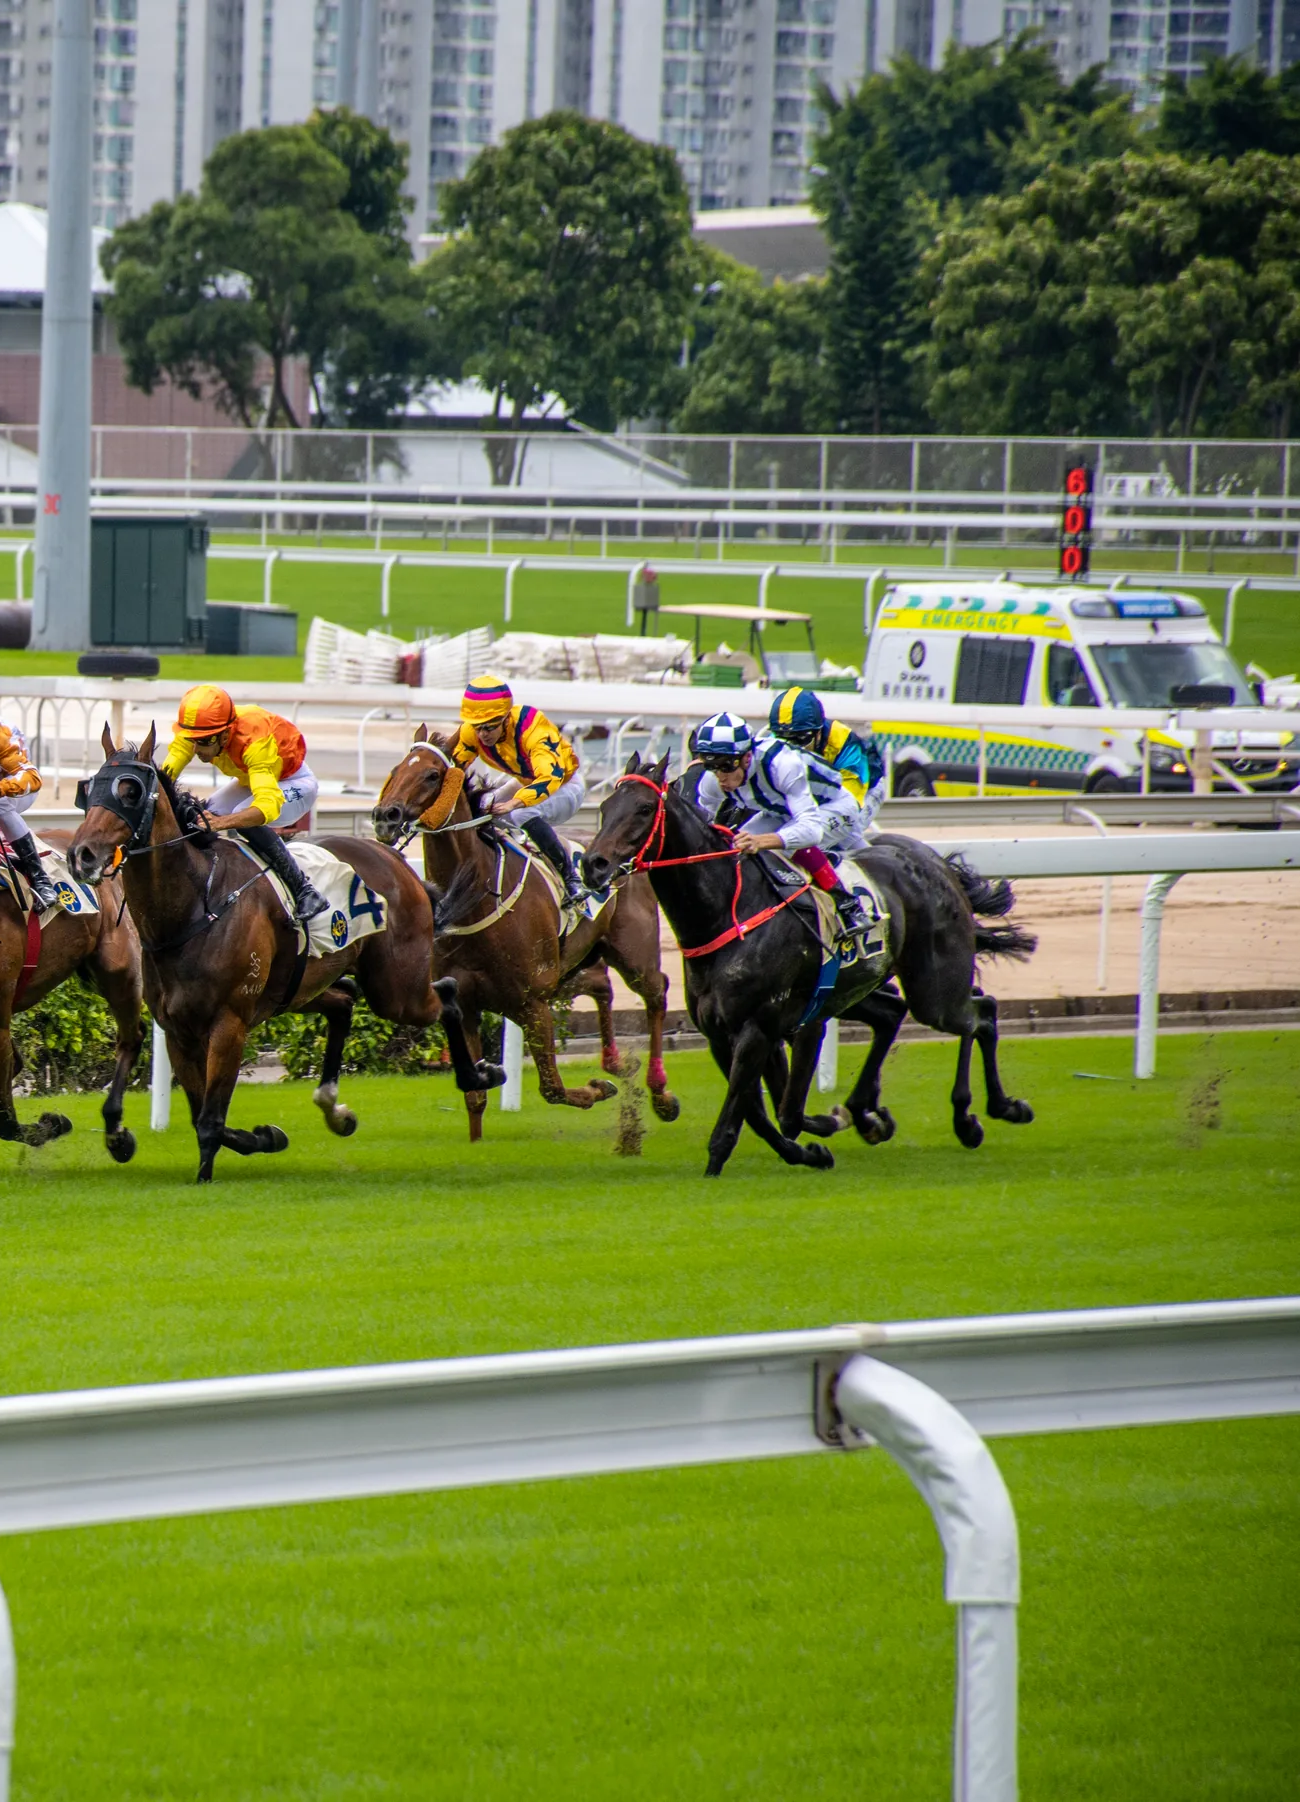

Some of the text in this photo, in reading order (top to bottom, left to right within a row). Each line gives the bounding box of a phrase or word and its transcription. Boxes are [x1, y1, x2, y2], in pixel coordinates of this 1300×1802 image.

[1061, 467, 1087, 575] 600
[921, 612, 1019, 631] EMERGENCY
[348, 873, 384, 930] 4
[853, 886, 883, 956] 2
